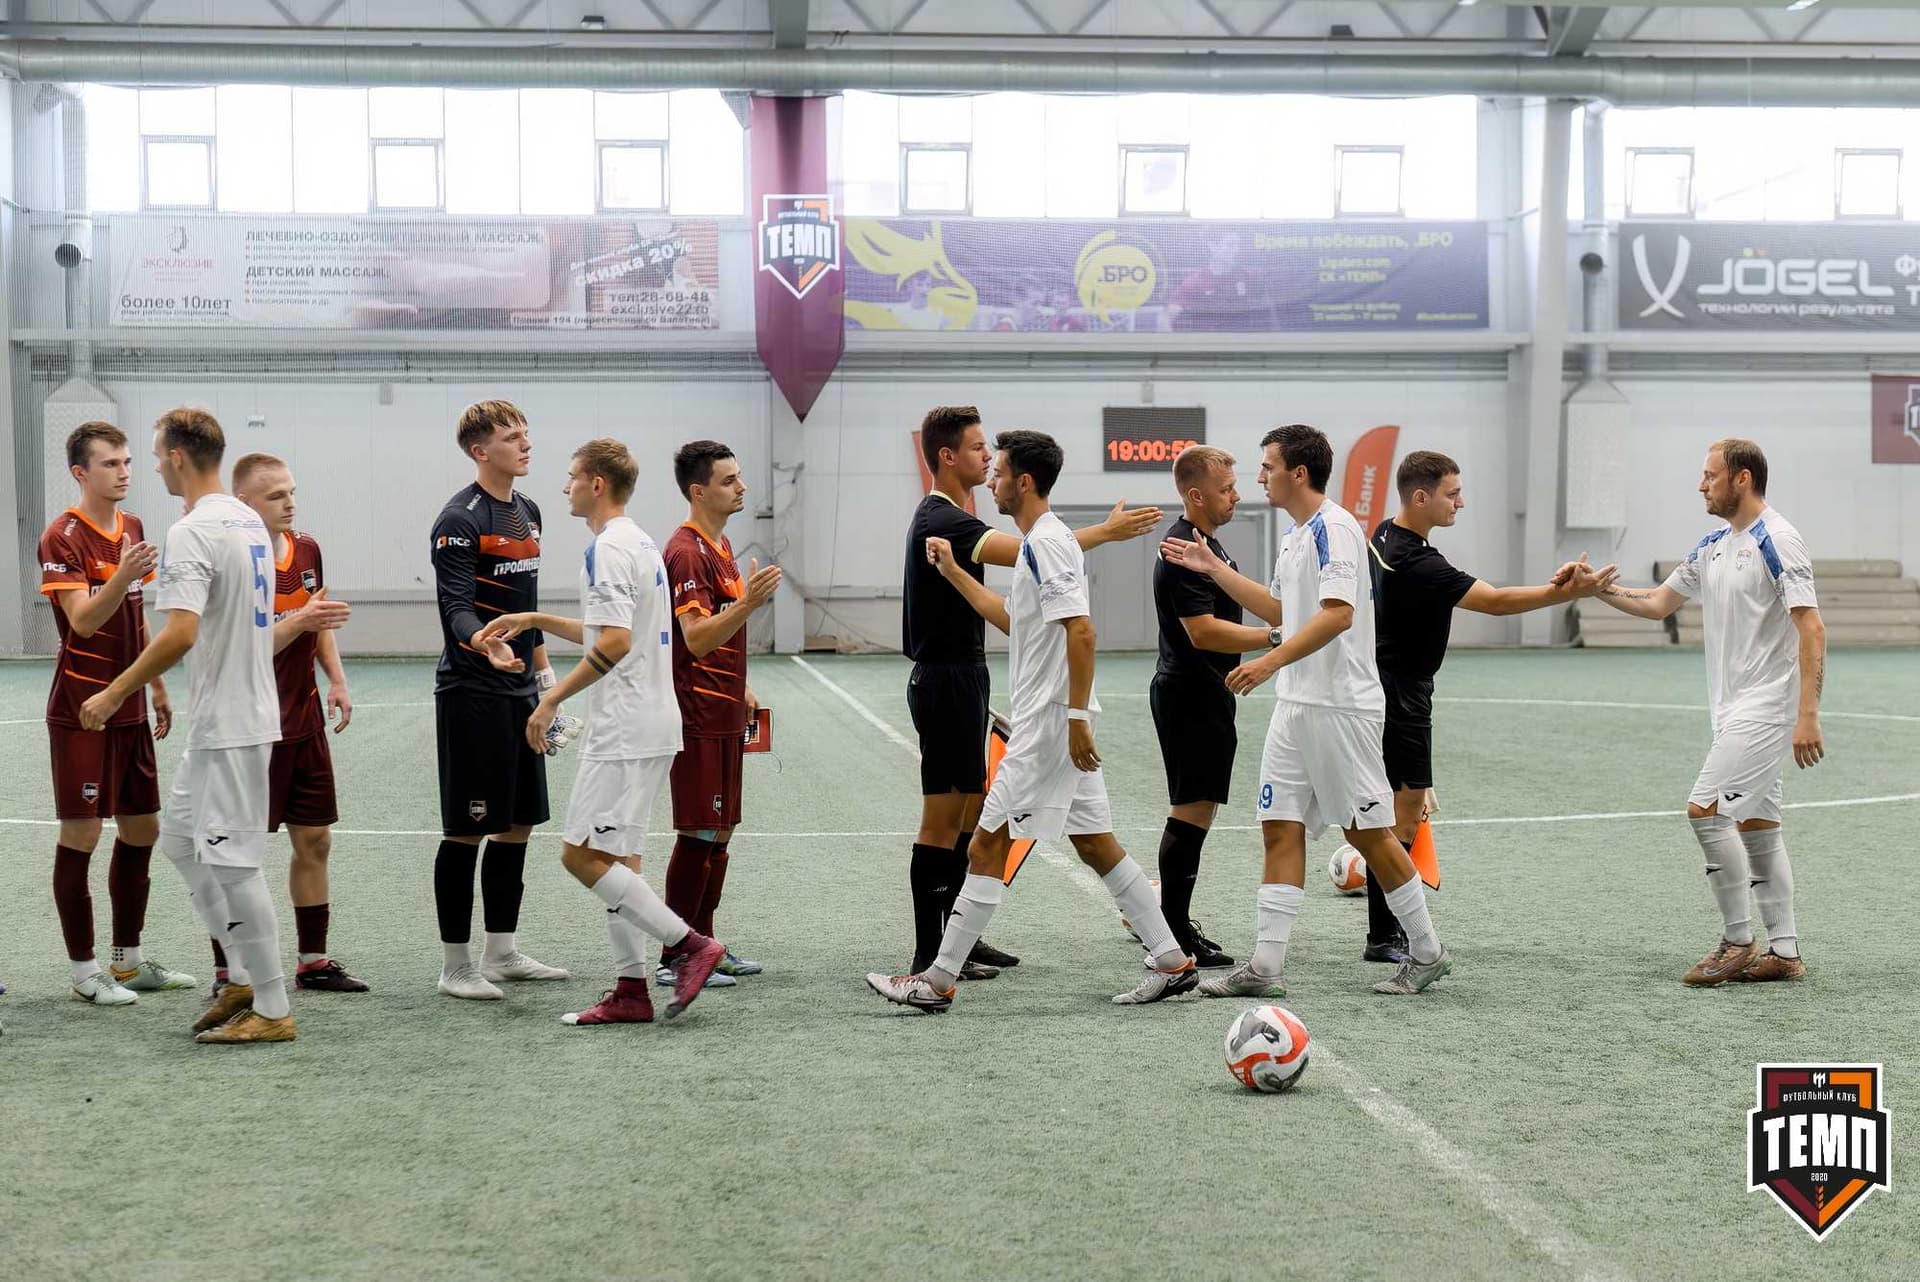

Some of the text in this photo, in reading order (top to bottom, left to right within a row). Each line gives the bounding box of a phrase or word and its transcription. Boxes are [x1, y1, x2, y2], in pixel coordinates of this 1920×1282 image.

[648, 237, 693, 264] 20%
[767, 223, 831, 259] ТЕМП
[246, 264, 314, 278] ДЕТСКИЙ
[1098, 265, 1147, 283] .БРО
[1697, 248, 1894, 296] JÖGEL
[1895, 254, 1920, 280] Ф
[121, 294, 232, 310] более 10лет
[1698, 303, 1895, 317] технологии результата
[1355, 464, 1377, 516] Банк
[249, 545, 267, 628] 5
